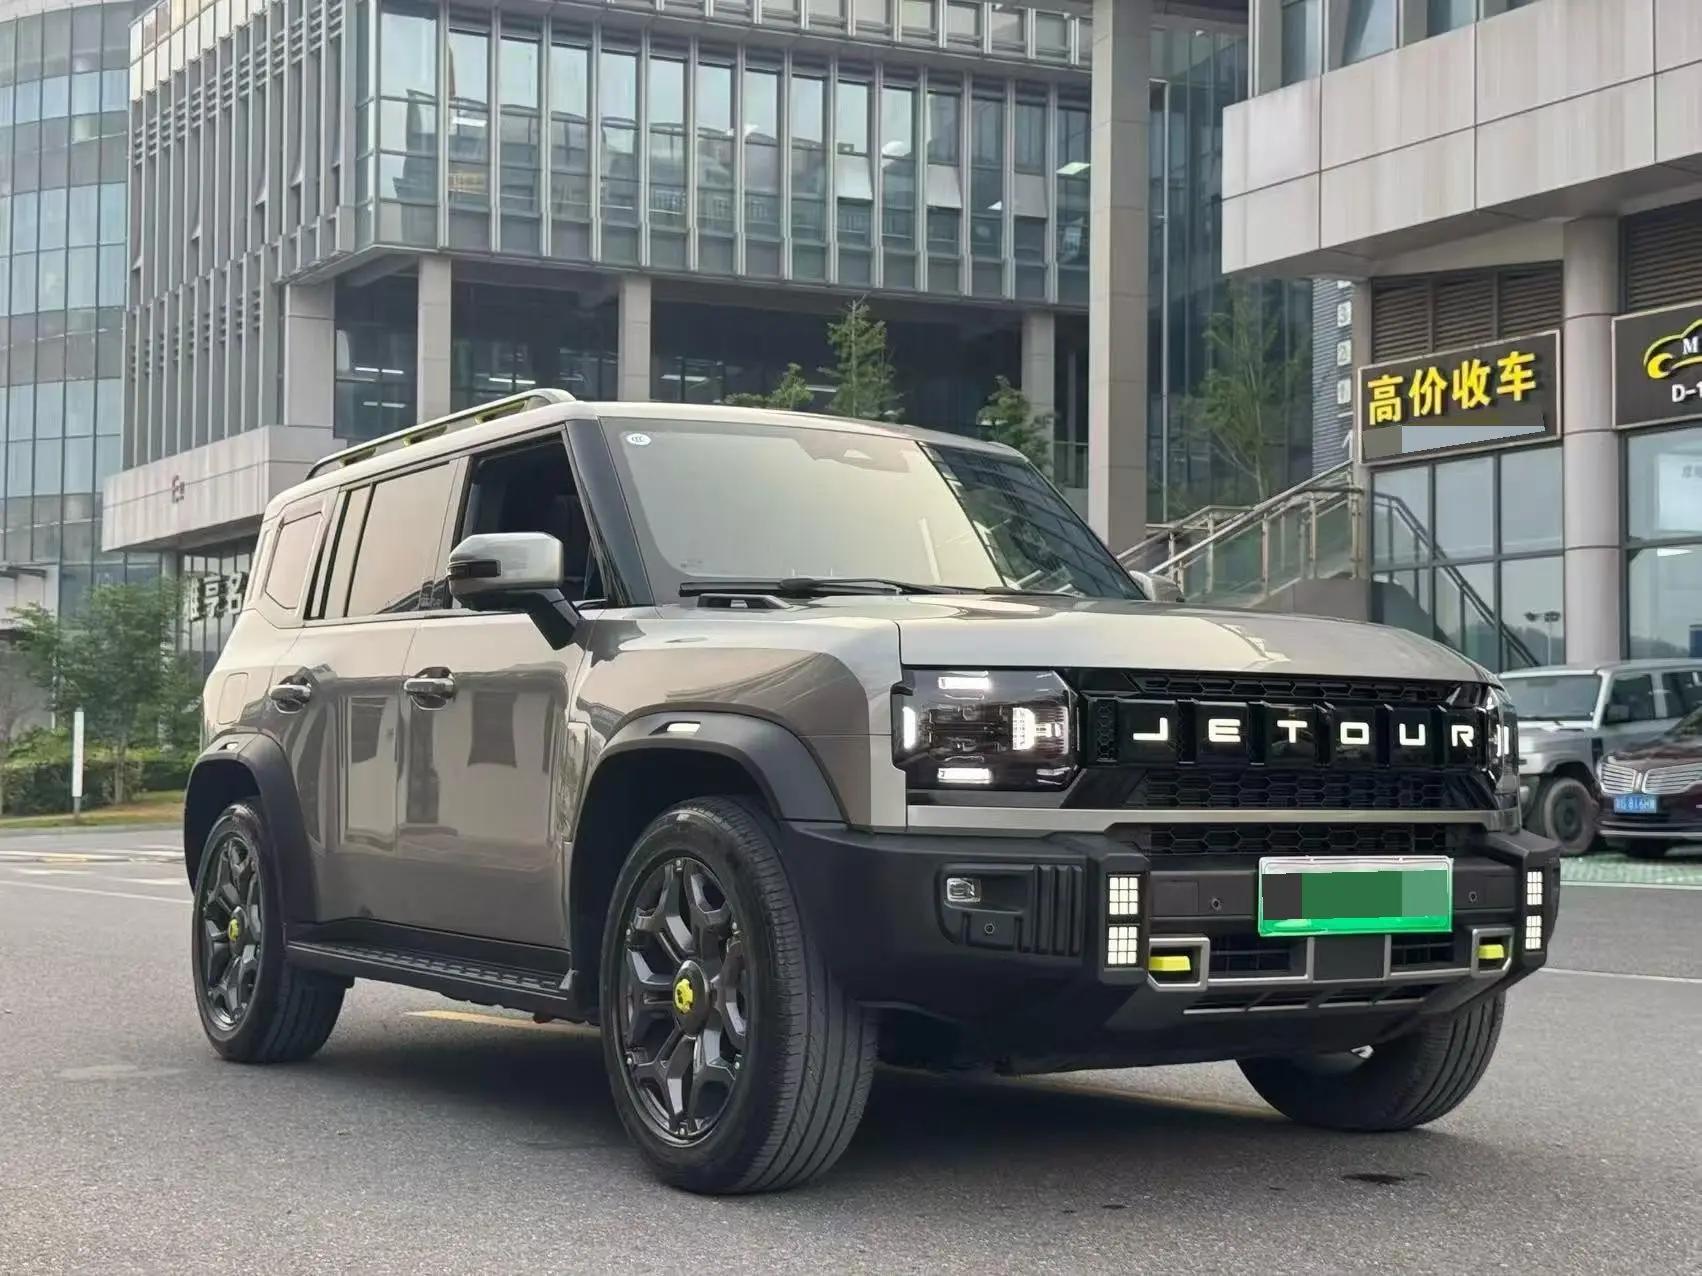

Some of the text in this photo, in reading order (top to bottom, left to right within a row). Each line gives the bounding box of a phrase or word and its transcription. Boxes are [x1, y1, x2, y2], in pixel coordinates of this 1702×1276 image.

[1366, 351, 1537, 426] 高价收车
[1132, 716, 1474, 748] JETOUR
